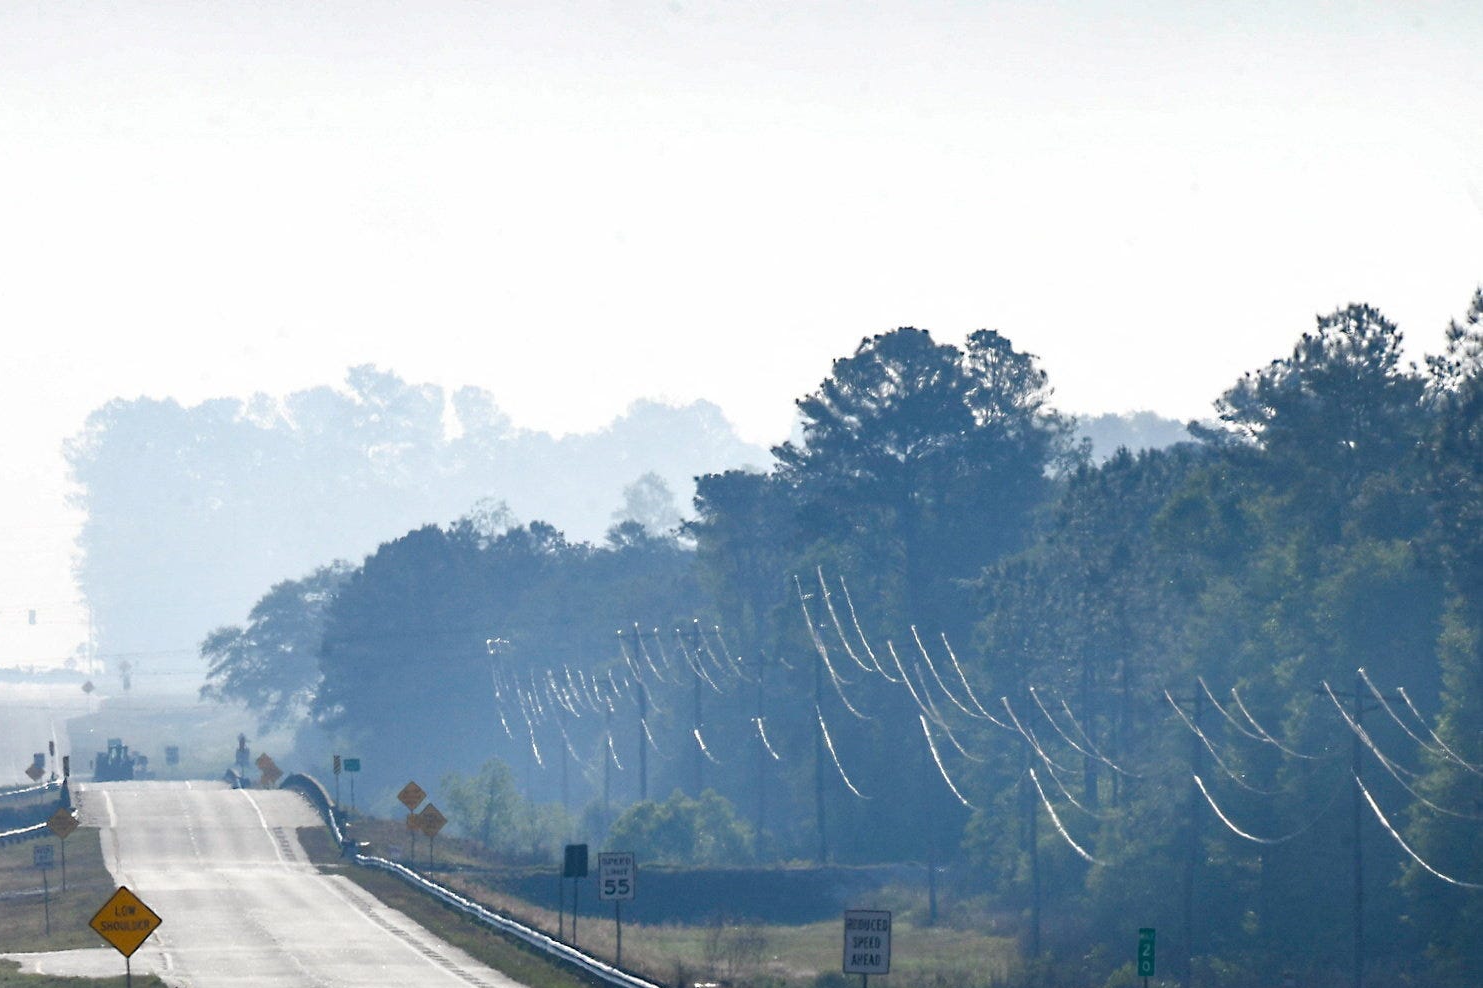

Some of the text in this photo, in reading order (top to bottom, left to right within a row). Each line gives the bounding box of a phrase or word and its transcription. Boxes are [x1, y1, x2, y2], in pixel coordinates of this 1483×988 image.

[602, 857, 632, 865] SPEED
[604, 879, 630, 895] 55
[114, 905, 136, 917] LOW
[101, 919, 150, 932] SHOULDER
[847, 919, 888, 931] REDUCED
[853, 936, 880, 949] SPEED
[851, 954, 881, 967] AHEAD
